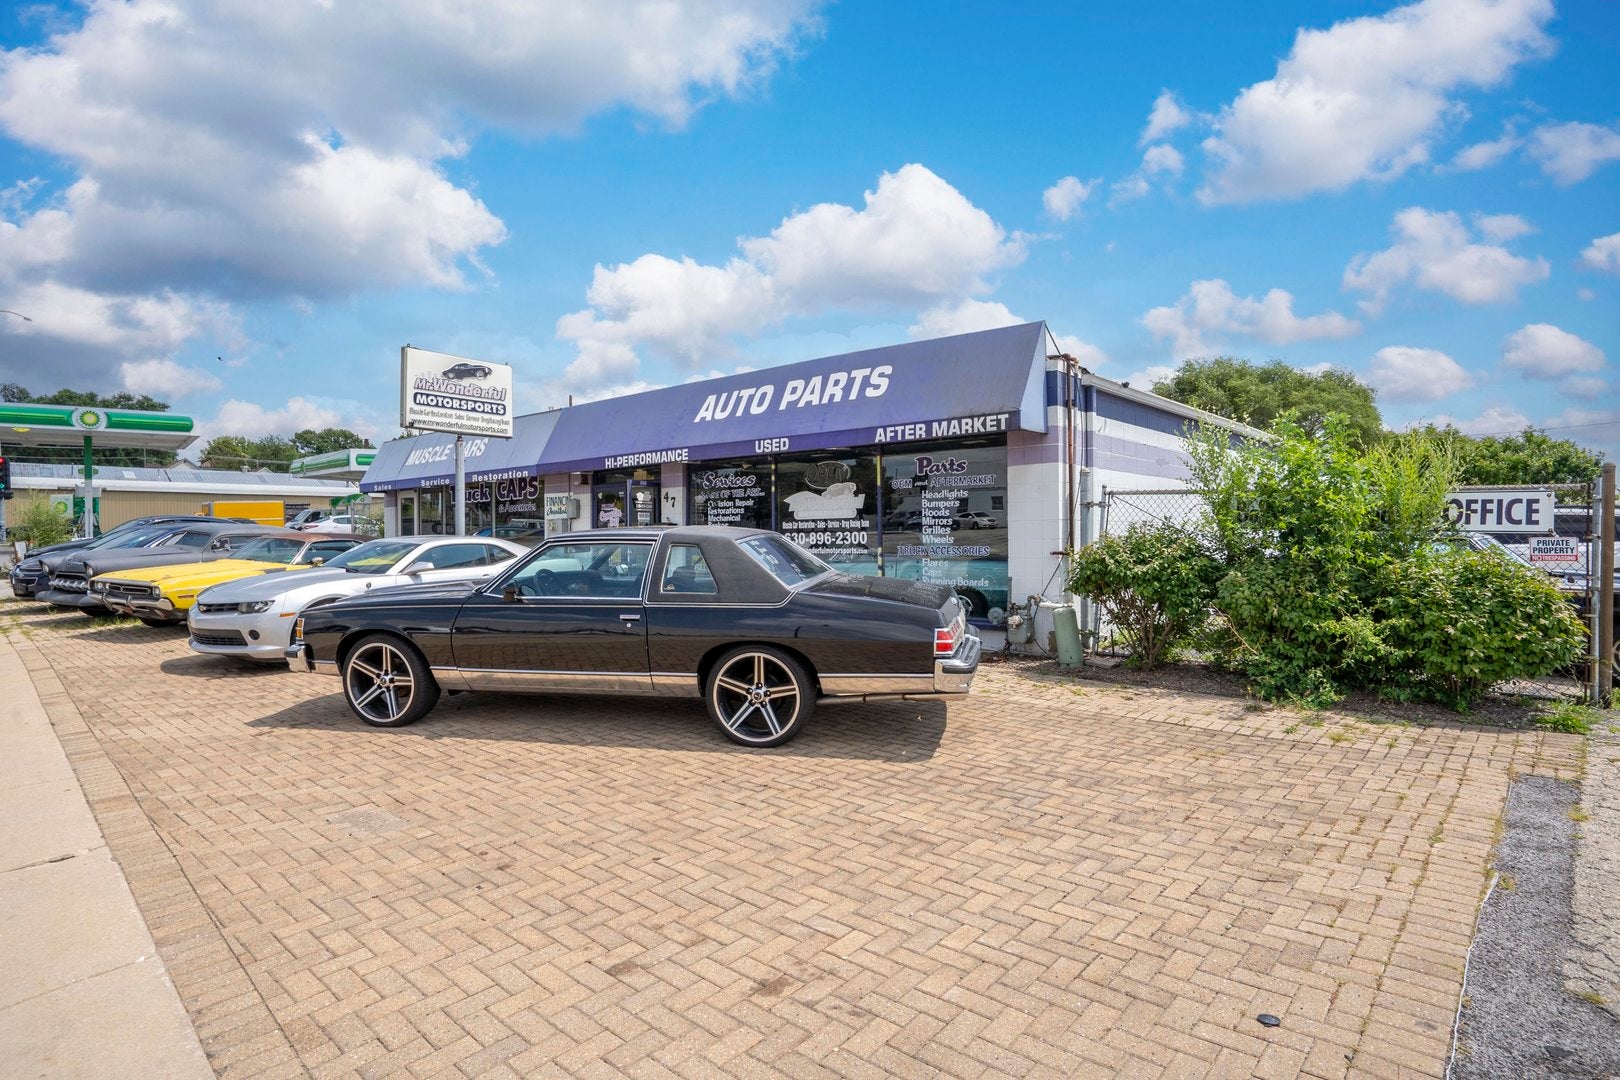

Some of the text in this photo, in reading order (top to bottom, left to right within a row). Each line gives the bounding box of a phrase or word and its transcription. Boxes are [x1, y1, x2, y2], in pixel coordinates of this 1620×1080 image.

[694, 365, 893, 423] AUTO PARTS
[415, 393, 505, 415] MOTORSPORTS
[875, 414, 1009, 443] AFTER MARKET
[755, 438, 789, 453] USED
[406, 438, 489, 466] MUSCLE ARS
[605, 448, 689, 469] HI-PERFORMANCE
[915, 456, 968, 476] Parts
[472, 470, 529, 482] Restoration
[703, 472, 757, 489] Services
[892, 479, 913, 489] OEM
[930, 474, 996, 488] AFTERMARKET
[420, 478, 450, 487] Service
[496, 477, 540, 500] CAPS
[922, 490, 969, 500] Headlights
[922, 500, 960, 509] Bumpers
[922, 508, 950, 517] Hoods
[1443, 498, 1540, 526] OFFICE
[922, 517, 954, 526] Mirrors
[922, 526, 951, 535] Grilles
[785, 532, 868, 545] 630-896-2300
[922, 535, 955, 544] Wheels
[897, 546, 991, 558] TRUCK ACCESSORIES
[922, 558, 949, 568] Flares
[922, 568, 942, 578] Caps
[957, 577, 990, 587] Boards
